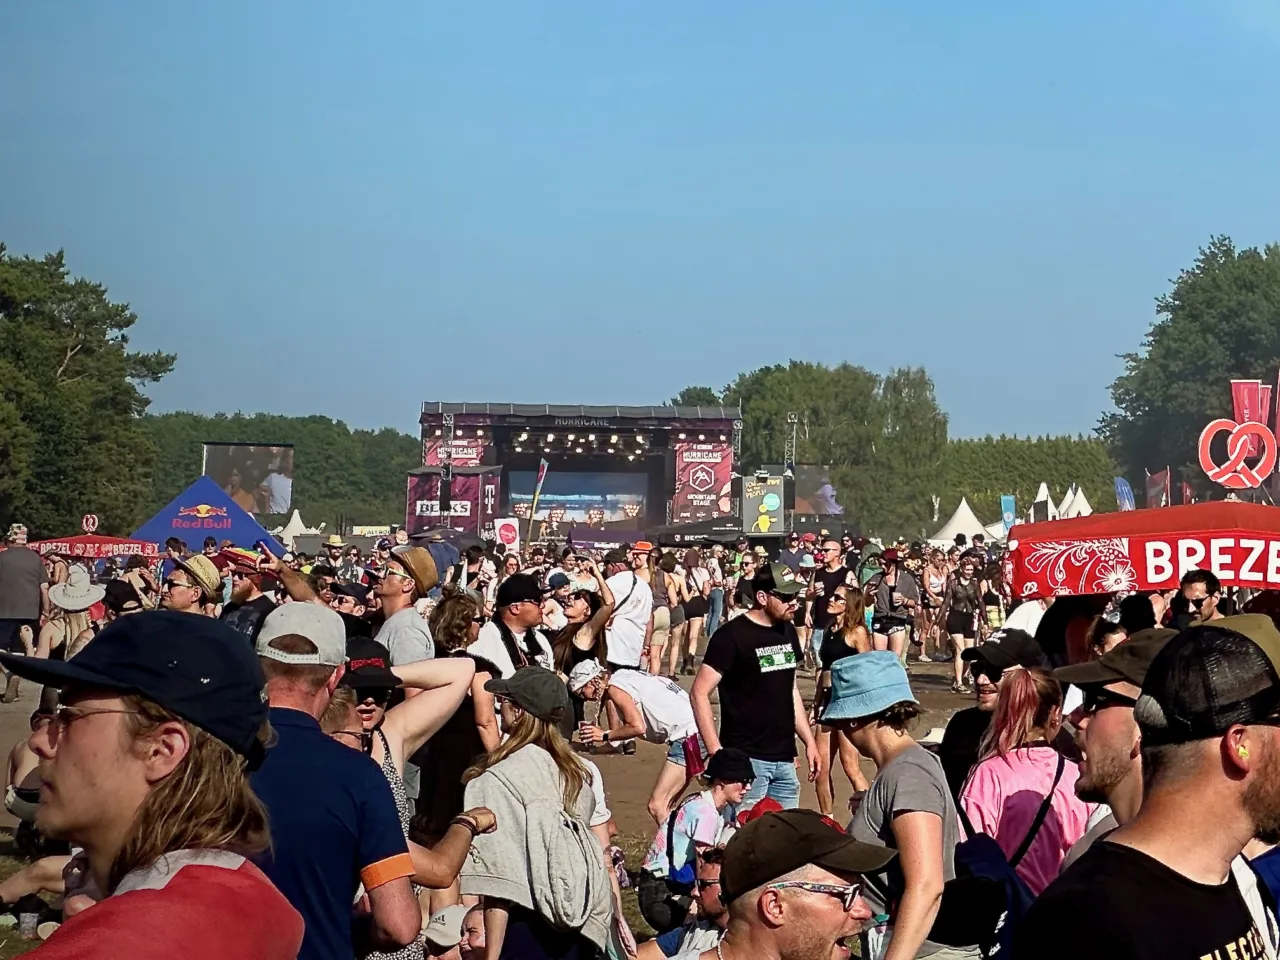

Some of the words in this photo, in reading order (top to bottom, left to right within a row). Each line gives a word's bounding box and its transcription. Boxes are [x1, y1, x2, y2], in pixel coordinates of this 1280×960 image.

[683, 451, 722, 459] HURRICANE
[420, 502, 468, 513] BEK'S
[172, 518, 201, 528] Red
[203, 518, 231, 528] Bull
[40, 543, 71, 555] BREZEL
[113, 544, 143, 555] BREZEL
[755, 643, 794, 657] HURRICANE
